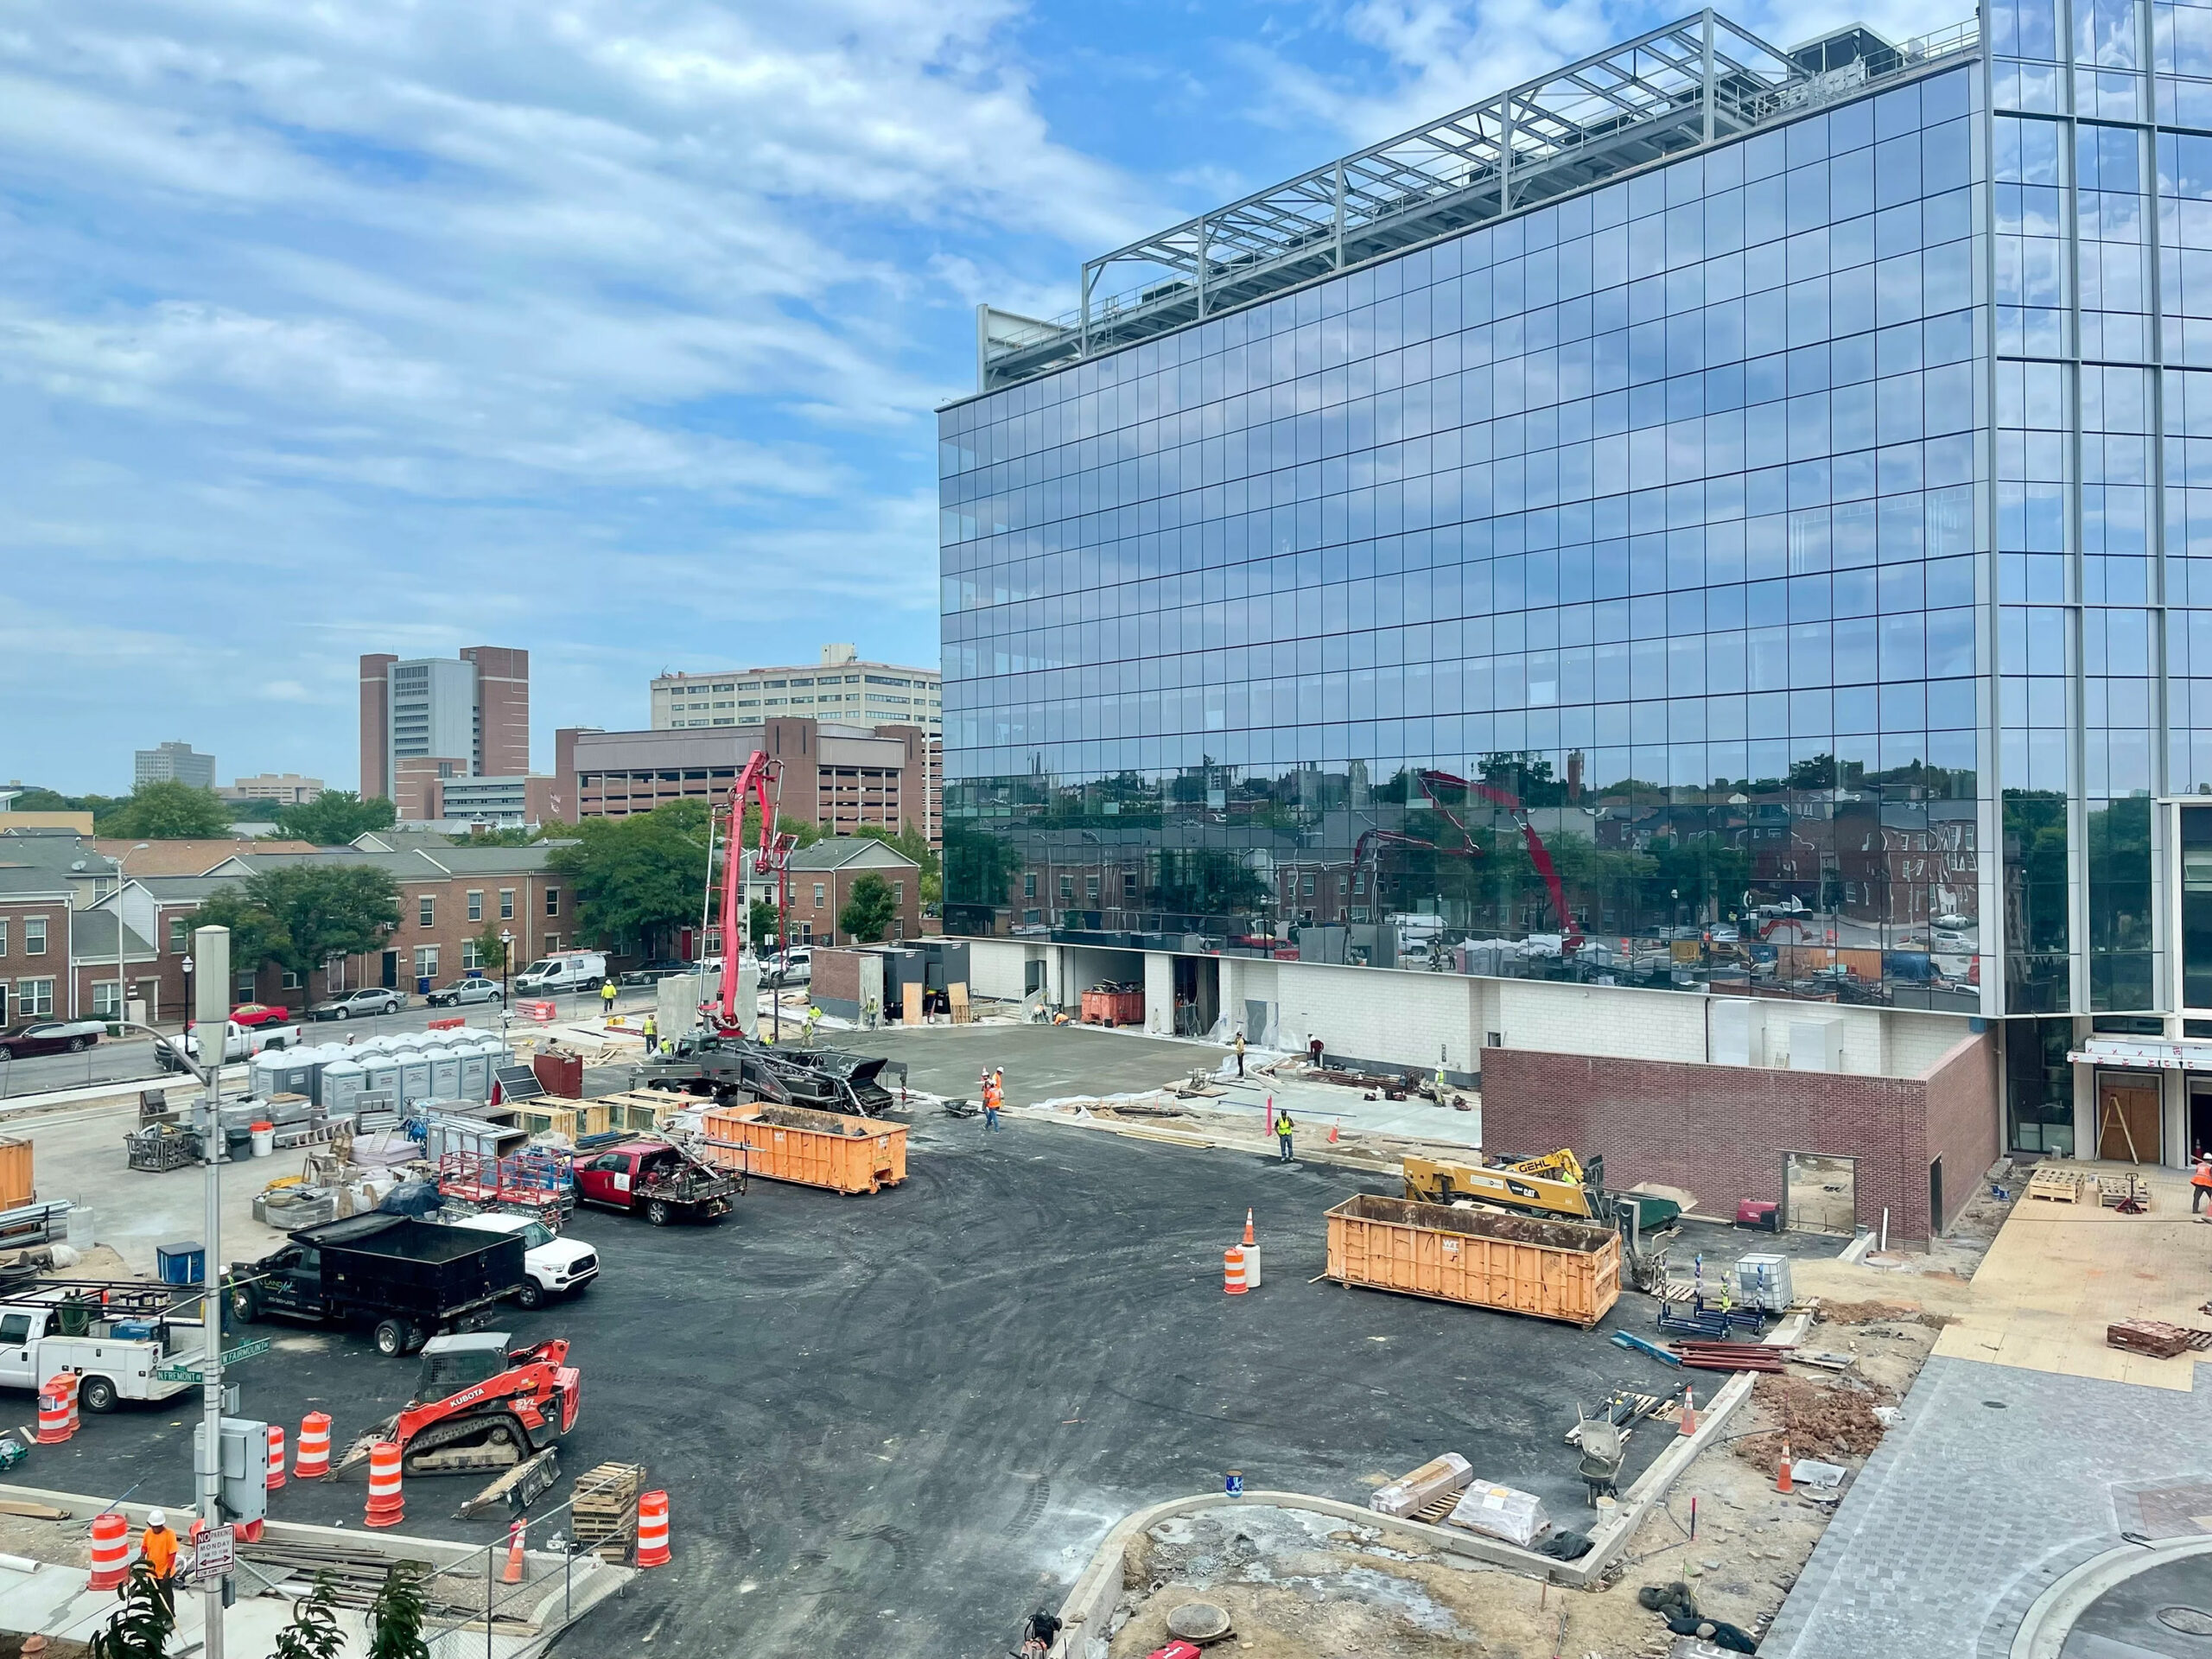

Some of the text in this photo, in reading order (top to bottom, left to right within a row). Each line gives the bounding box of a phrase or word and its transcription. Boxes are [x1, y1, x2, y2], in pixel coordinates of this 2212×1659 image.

[1519, 1160, 1551, 1173] GEHL
[1523, 1188, 1535, 1198] CAT
[1442, 1239, 1459, 1249] WT
[264, 1279, 283, 1287] LAND
[222, 1354, 229, 1363] W
[228, 1342, 264, 1363] FAIRMOUNT
[157, 1371, 164, 1380] N
[164, 1371, 195, 1382] FREMONT
[449, 1388, 485, 1408] KUBOTA
[198, 1529, 232, 1543] NO PARKING
[200, 1541, 230, 1552] MONDAY
